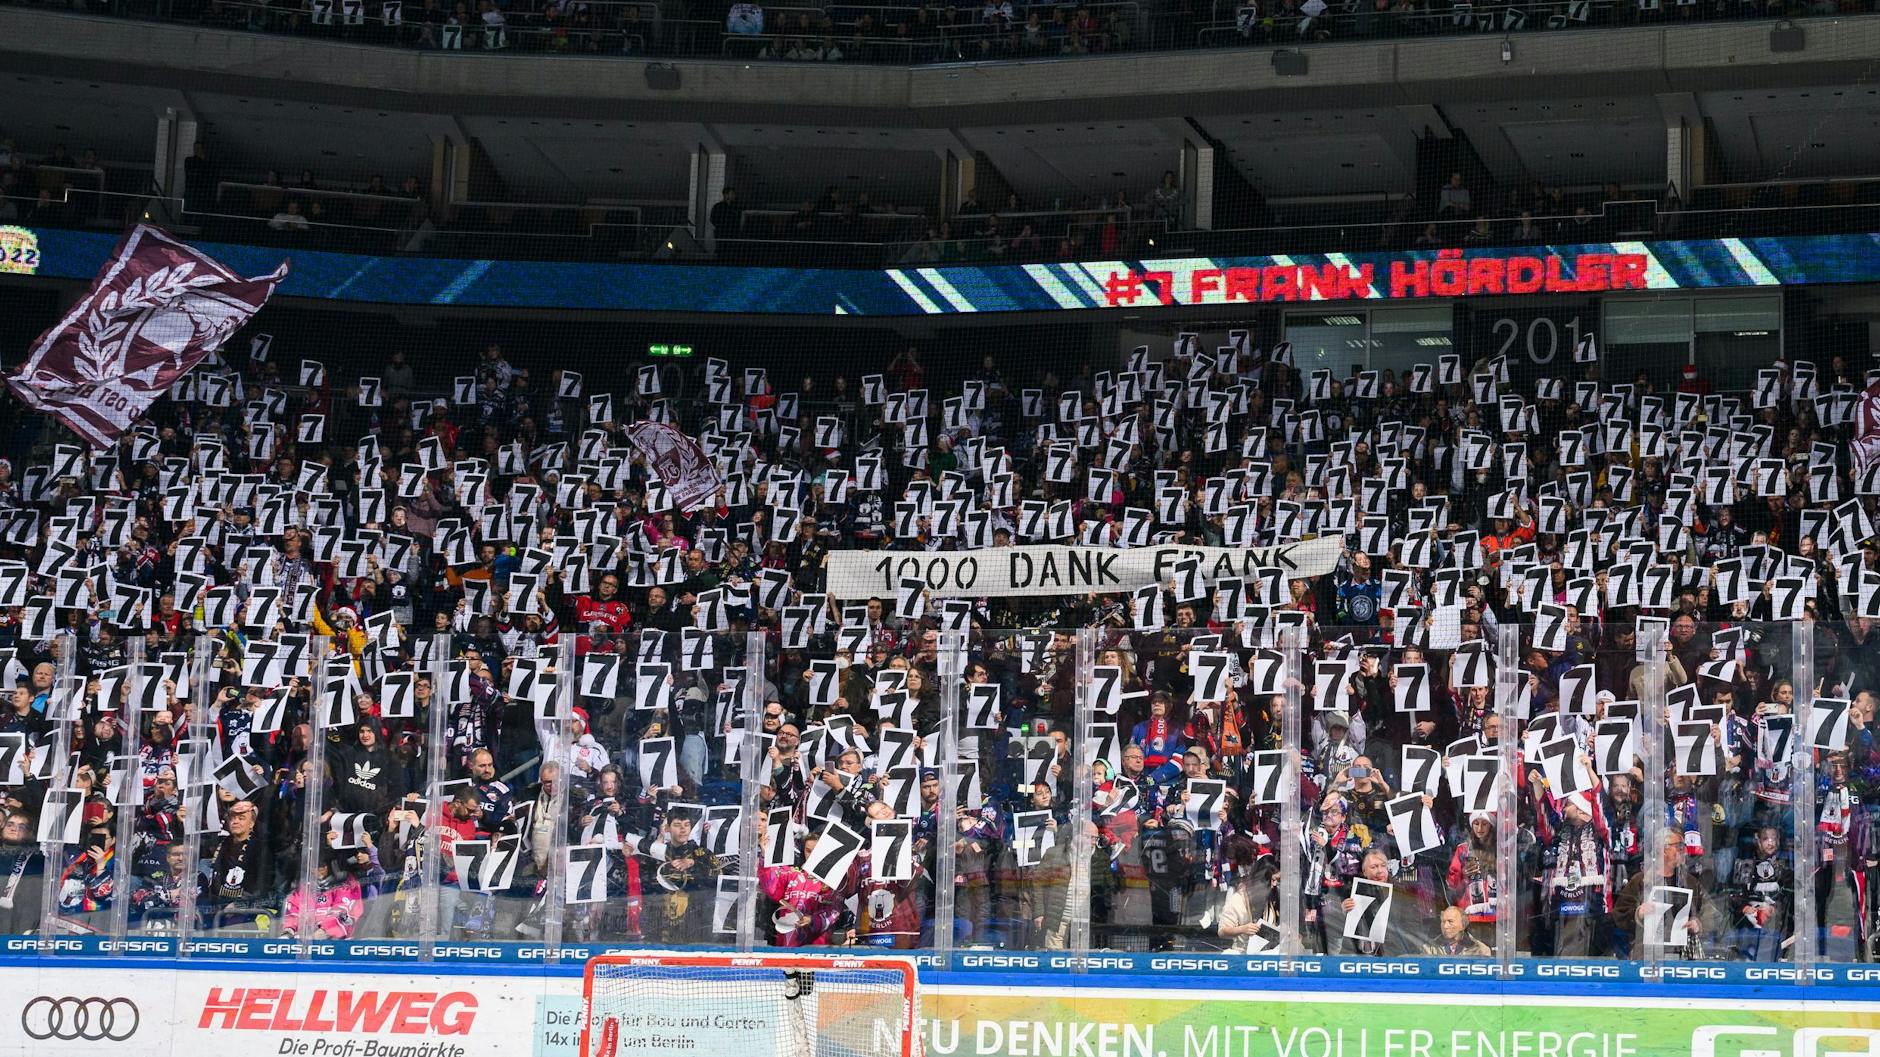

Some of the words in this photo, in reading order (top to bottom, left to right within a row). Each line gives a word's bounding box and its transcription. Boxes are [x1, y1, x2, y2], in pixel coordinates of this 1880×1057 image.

[1105, 269, 1173, 306] #7
[1191, 263, 1373, 304] FRANK
[1390, 247, 1648, 298] HÖRDLER
[1492, 316, 1579, 365] 201
[1312, 371, 1328, 398] 7
[1441, 356, 1458, 382] 7
[1796, 372, 1814, 398] 7
[361, 379, 378, 404] 7
[1477, 376, 1493, 402] 7
[724, 405, 741, 430] 7
[945, 398, 962, 427] 7
[1504, 401, 1523, 430] 7
[252, 428, 268, 457] 7
[819, 419, 836, 445] 7
[1562, 433, 1582, 464] 7
[1643, 425, 1662, 455] 7
[95, 457, 117, 488] 7
[1110, 440, 1131, 470] 7
[1506, 445, 1524, 476] 7
[463, 475, 485, 505] 7
[564, 477, 583, 507] 7
[728, 474, 742, 504] 7
[828, 472, 846, 501] 7
[1092, 471, 1112, 501] 7
[1250, 465, 1269, 494] 7
[1708, 468, 1730, 503] 7
[1811, 466, 1833, 500] 7
[105, 511, 127, 545] 7
[777, 509, 797, 540] 7
[935, 503, 955, 534] 7
[1226, 508, 1247, 542] 7
[1332, 500, 1352, 527] 7
[389, 536, 411, 569] 7
[595, 536, 620, 568] 7
[1364, 520, 1386, 553] 7
[179, 539, 203, 571] 7
[662, 549, 678, 582] 7
[875, 556, 978, 591] 1000
[1010, 549, 1120, 588] DANK
[1840, 552, 1862, 593] 7
[60, 570, 88, 606] 7
[464, 580, 488, 613] 7
[512, 575, 536, 611] 7
[764, 571, 788, 608] 7
[1175, 559, 1198, 599] 7
[1259, 569, 1283, 605] 7
[1436, 570, 1460, 606] 7
[1525, 568, 1548, 609] 7
[1609, 564, 1633, 605] 7
[1647, 567, 1670, 605] 7
[1719, 560, 1742, 601] 7
[115, 586, 141, 624] 7
[207, 590, 230, 624] 7
[296, 585, 318, 620] 7
[698, 591, 721, 630] 7
[901, 579, 925, 616] 7
[1219, 579, 1242, 619] 7
[1776, 579, 1803, 618] 7
[27, 598, 52, 635] 7
[784, 609, 809, 646] 7
[1540, 604, 1566, 648] 7
[281, 636, 306, 675] 7
[1257, 648, 1283, 691] 7
[137, 665, 164, 708] 7
[588, 654, 617, 694] 7
[640, 666, 668, 707] 7
[812, 663, 836, 703] 7
[1198, 656, 1227, 699] 7
[1318, 664, 1346, 708] 7
[1393, 666, 1425, 709] 7
[1563, 668, 1592, 712] 7
[260, 688, 288, 731] 7
[385, 675, 411, 715] 7
[538, 670, 563, 717] 7
[974, 687, 997, 726] 7
[1766, 718, 1793, 763] 7
[1813, 700, 1847, 747] 7
[643, 740, 672, 789] 7
[884, 730, 913, 772] 7
[1597, 722, 1630, 772] 7
[1678, 724, 1711, 773] 7
[213, 756, 258, 794] 7
[348, 776, 377, 791] adidas
[1258, 753, 1289, 801] 7
[1406, 748, 1437, 794] 7
[1543, 738, 1578, 795] 7
[1467, 759, 1500, 810] 7
[1191, 782, 1223, 828] 7
[1391, 796, 1425, 851] 7
[456, 844, 487, 891] 7
[488, 838, 519, 887] 7
[814, 826, 857, 880] 7
[876, 823, 908, 877] 7
[569, 847, 603, 901] 7
[1355, 882, 1389, 937] 7
[8, 940, 82, 951] GASAG
[99, 941, 169, 952] GASAG
[179, 942, 249, 954] GASAG
[263, 943, 334, 956] GASAG
[350, 945, 419, 957] GASAG
[432, 946, 501, 959] GASAG
[518, 948, 589, 959] GASAG
[963, 956, 1039, 968] GASAG
[1051, 957, 1133, 969] GASAG
[1151, 958, 1229, 971] GASAG
[1247, 960, 1321, 972] GASAG
[1340, 962, 1419, 974] GASAG
[1439, 963, 1523, 975] GASAG
[1537, 964, 1619, 977] GASAG
[1639, 966, 1726, 979] GASAG
[1746, 968, 1833, 980] GASAG
[198, 987, 479, 1036] HELLWEG
[547, 1011, 571, 1025] Die
[278, 1038, 309, 1056] Die
[312, 1039, 465, 1057] Profi-Baumärkte
[545, 1032, 568, 1046] 14x
[651, 1035, 695, 1049] Berlin
[976, 1020, 1167, 1057] DENKEN.
[1184, 1025, 1259, 1057] MIT
[1452, 1028, 1637, 1057] ENERGIE
